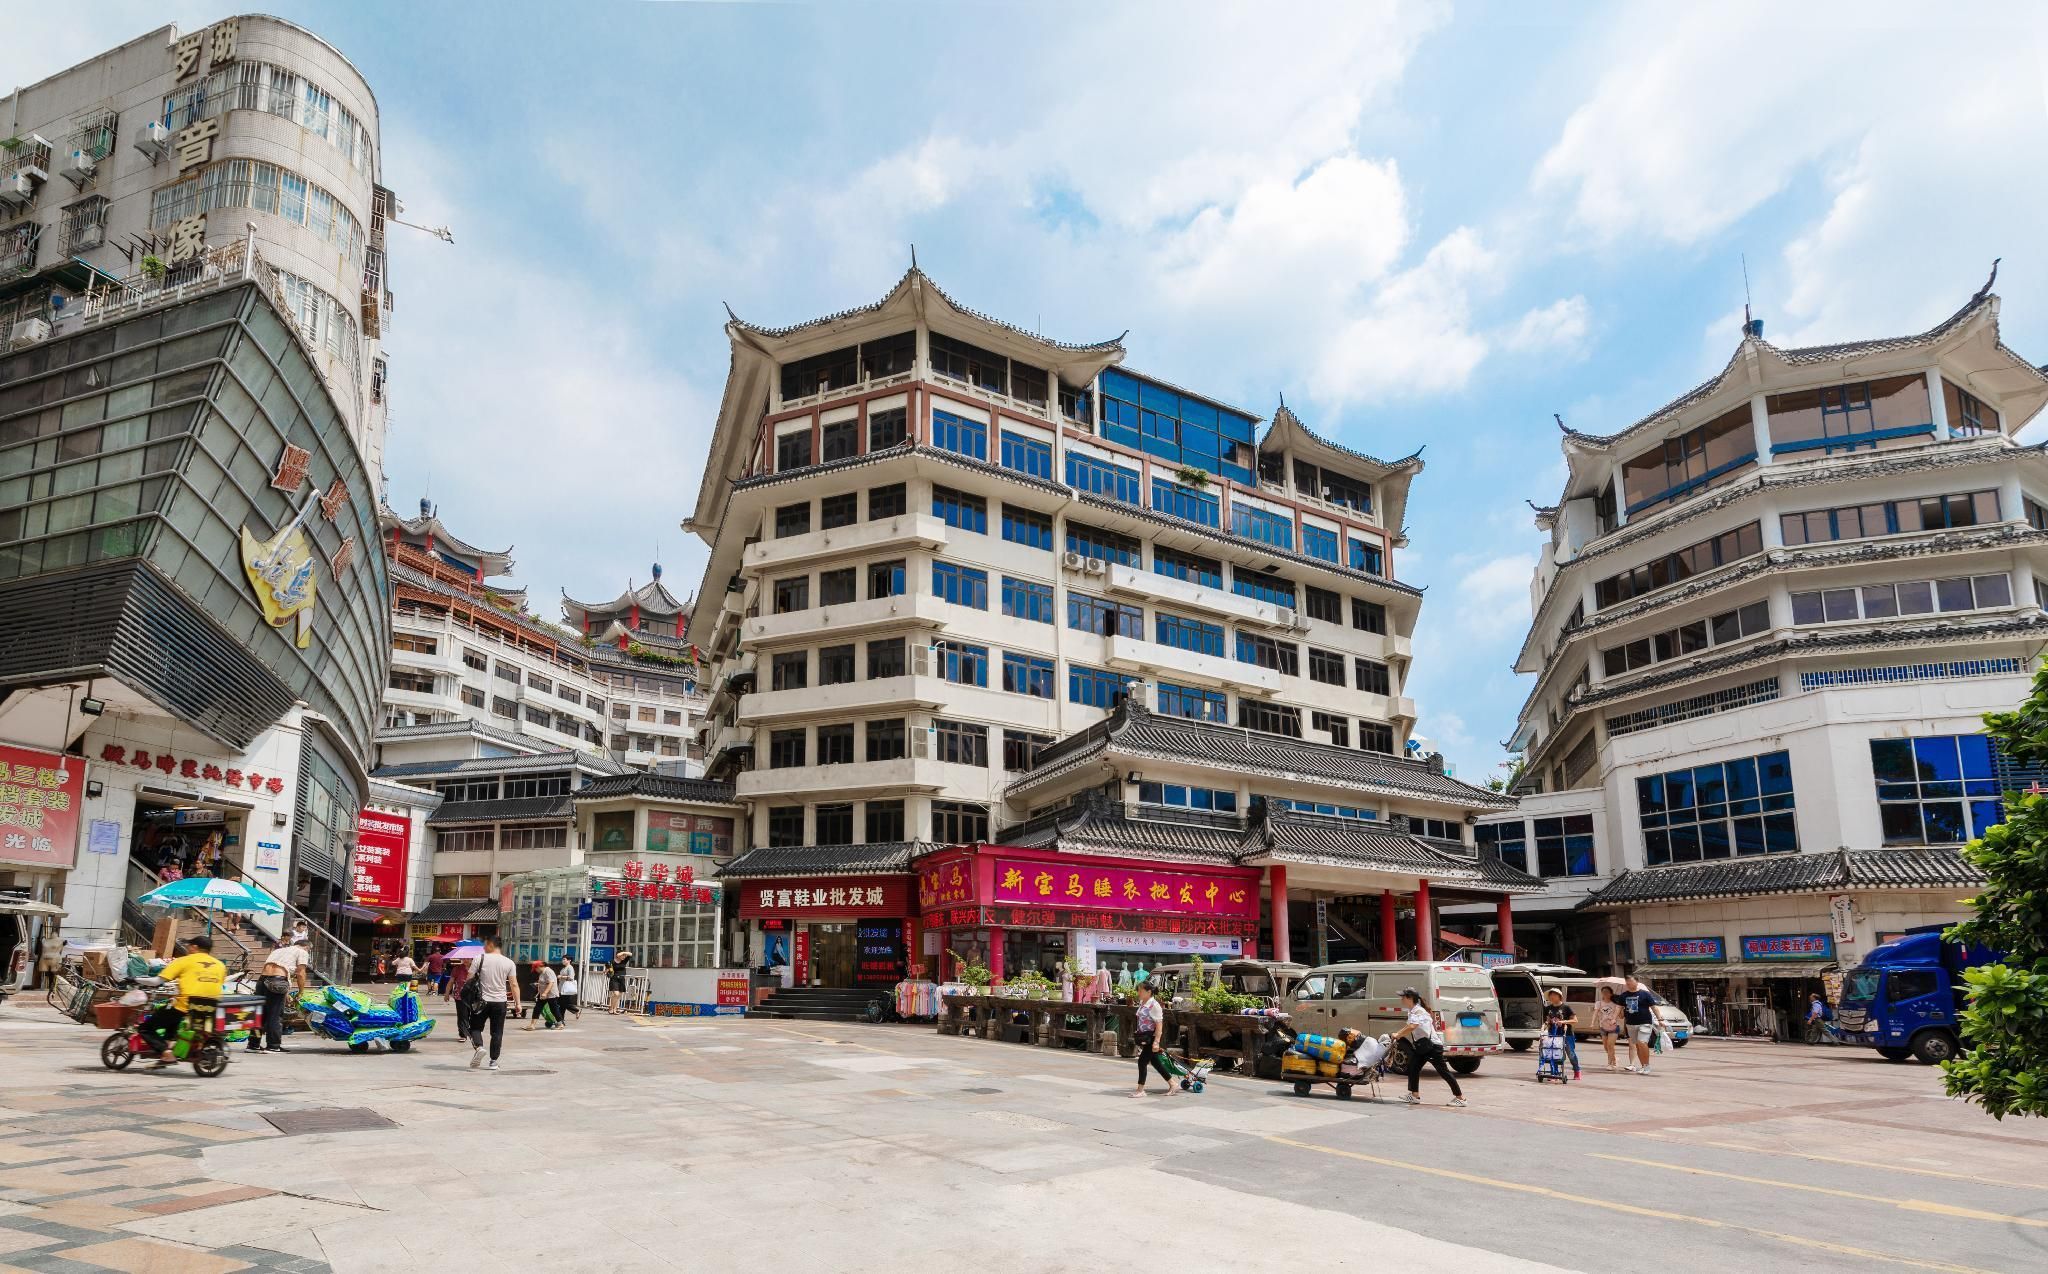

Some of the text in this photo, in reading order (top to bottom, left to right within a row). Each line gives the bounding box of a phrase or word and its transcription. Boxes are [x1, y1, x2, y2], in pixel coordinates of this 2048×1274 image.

[175, 22, 239, 82] 罗湖
[5, 833, 52, 852] 光临
[624, 859, 694, 884] 新华城
[760, 886, 884, 908] 贤富鞋业批发城
[1001, 867, 1246, 909] 新宝马睡衣批发中心
[1653, 942, 1717, 954] 福业衣架五金店
[1749, 939, 1824, 952] 福业衣架五金店
